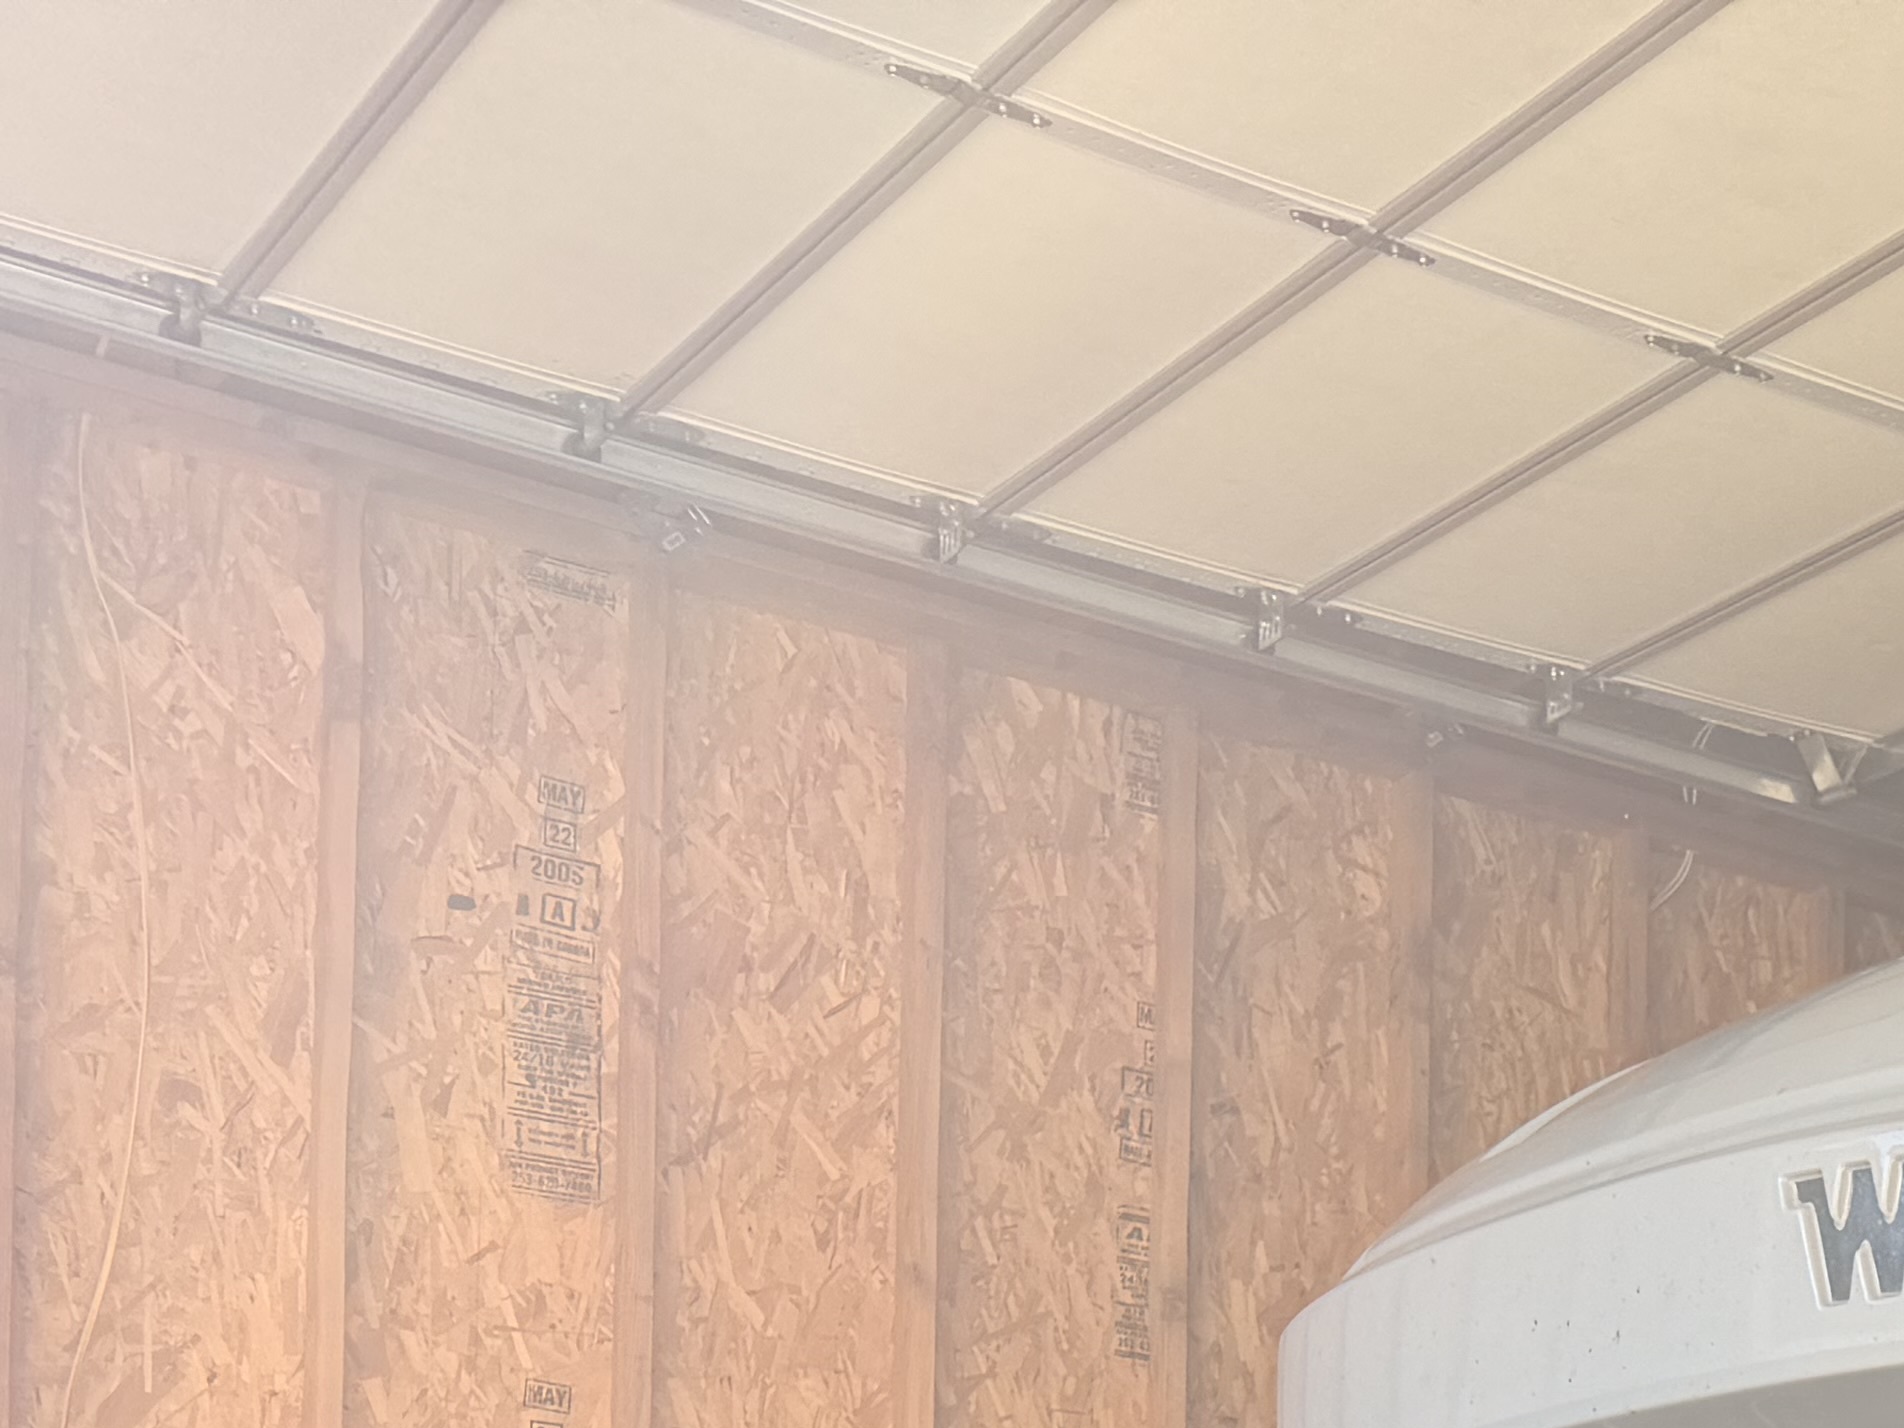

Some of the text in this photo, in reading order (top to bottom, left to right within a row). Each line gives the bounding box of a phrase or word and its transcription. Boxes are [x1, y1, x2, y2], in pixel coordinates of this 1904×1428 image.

[542, 781, 582, 808] MAY
[549, 824, 573, 847] 22
[530, 855, 585, 886] 2005
[551, 900, 566, 923] A
[528, 1384, 567, 1409] MAY
